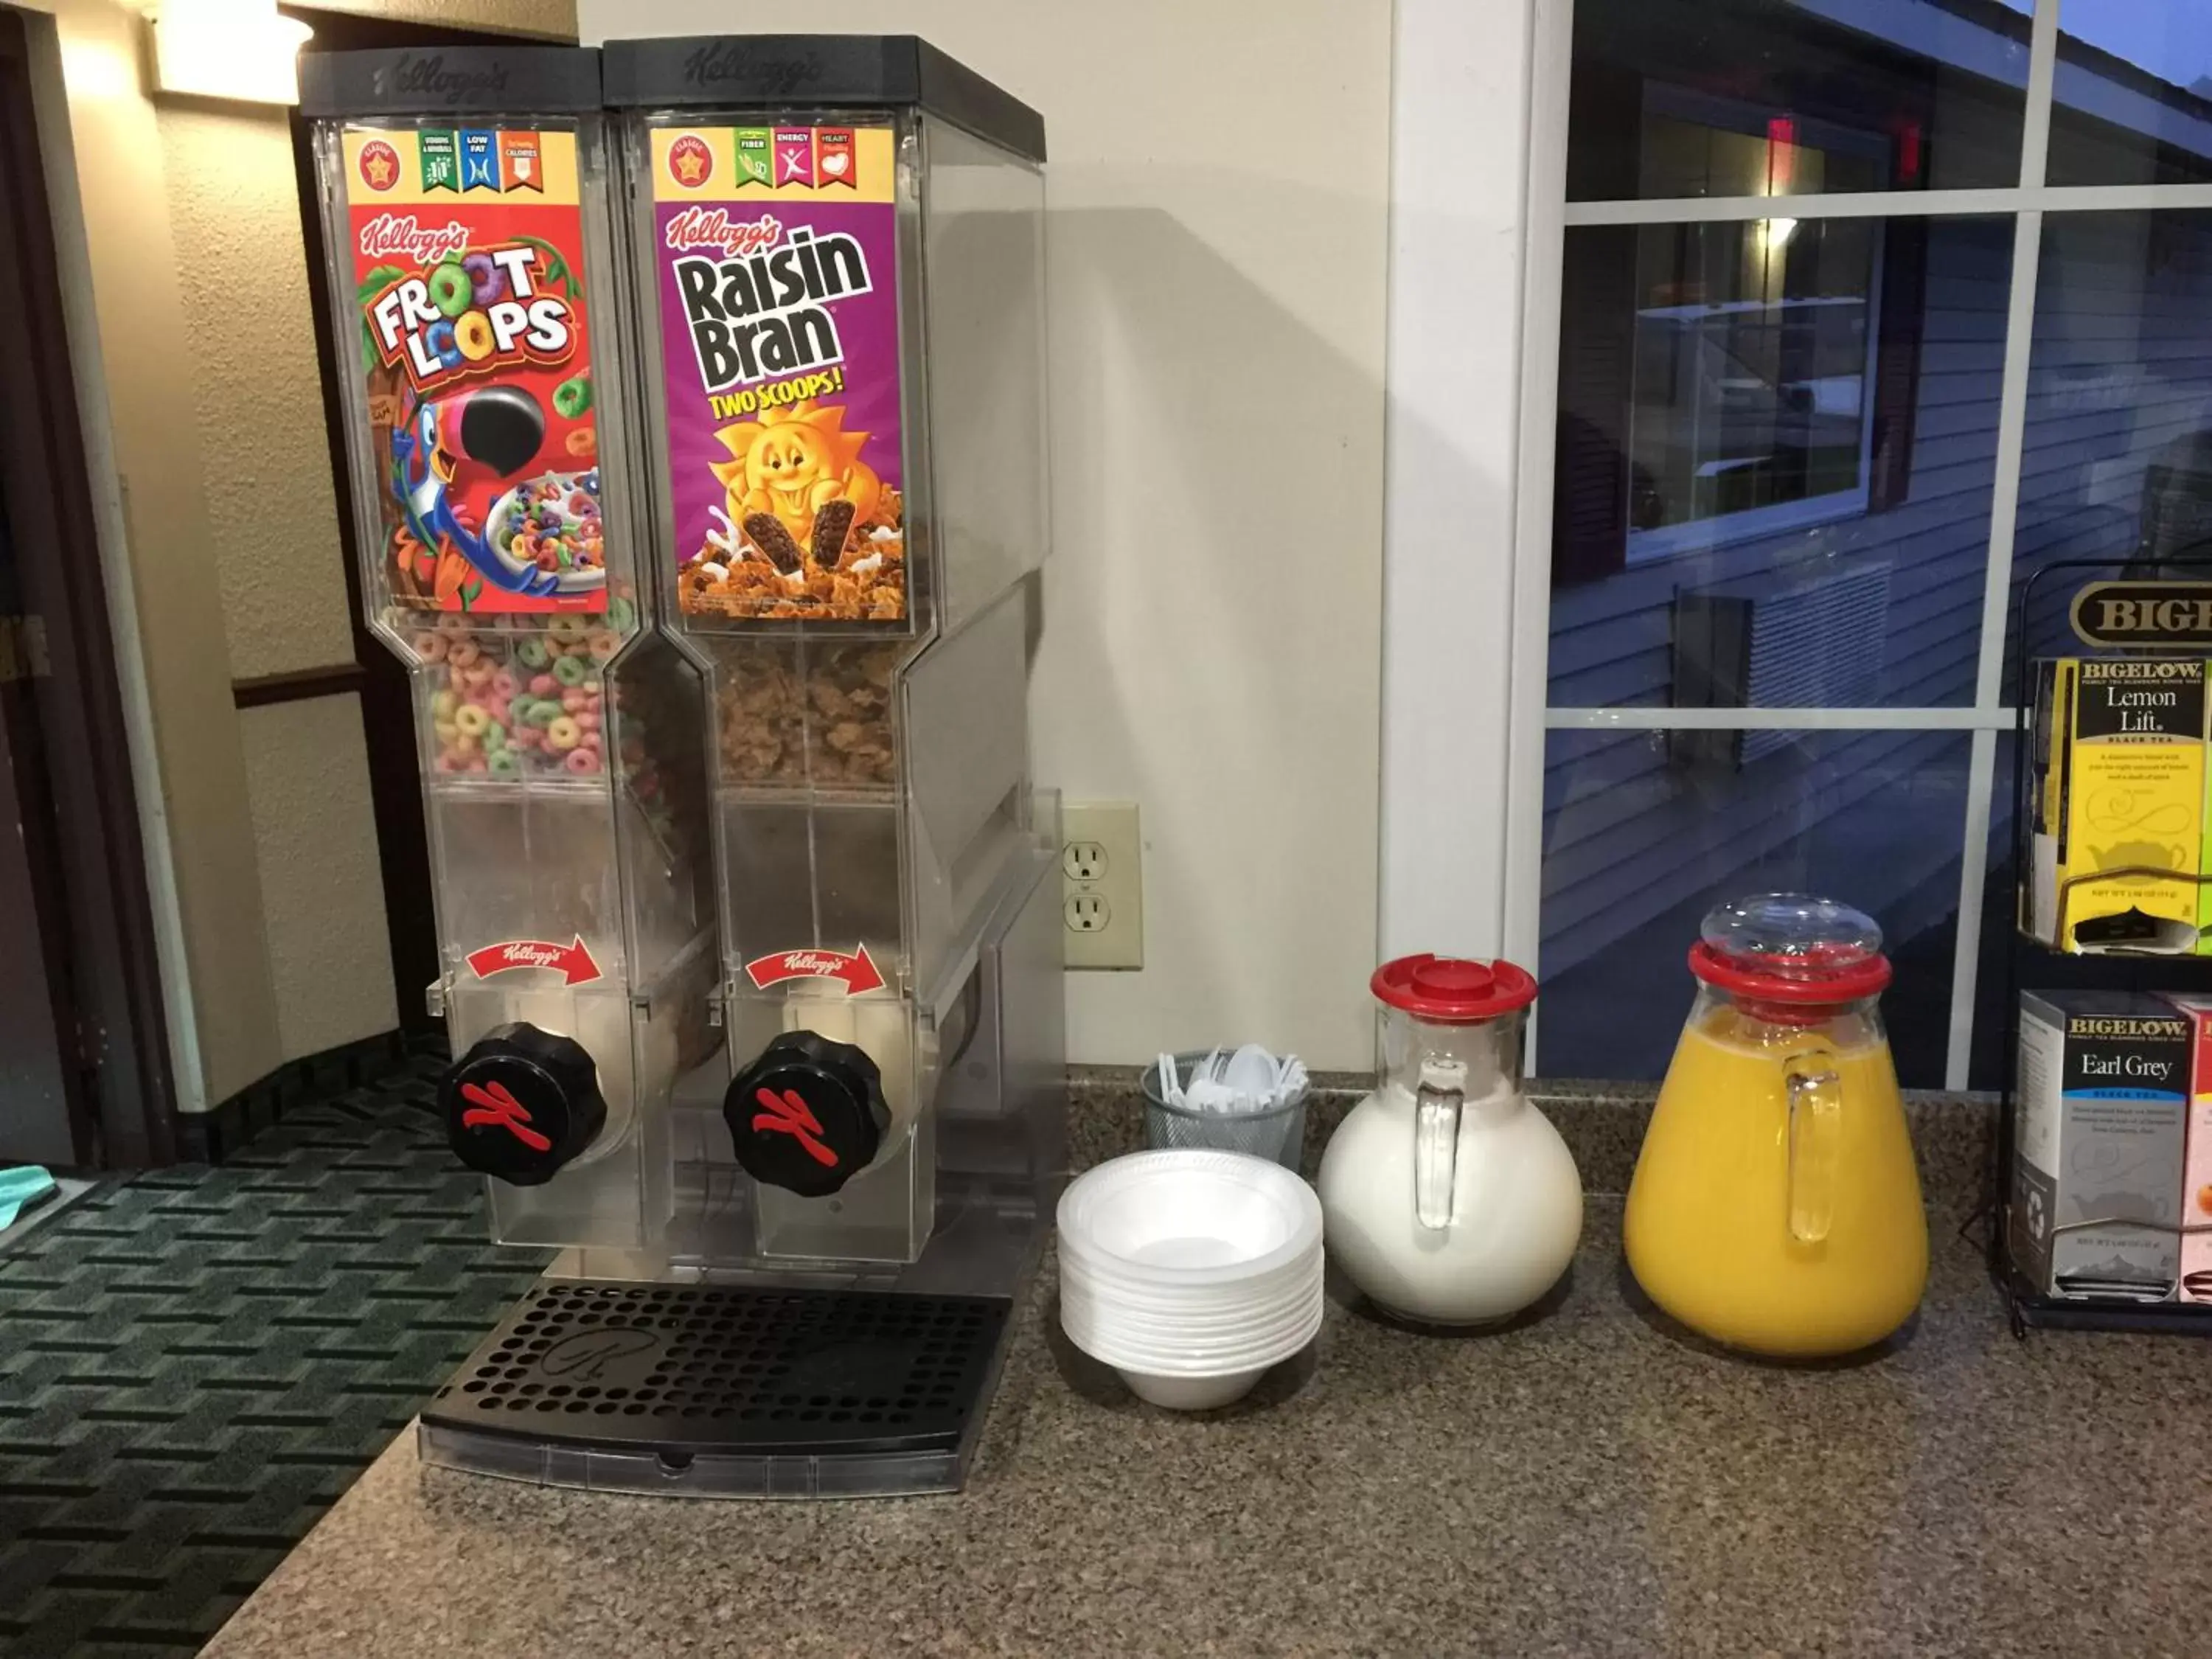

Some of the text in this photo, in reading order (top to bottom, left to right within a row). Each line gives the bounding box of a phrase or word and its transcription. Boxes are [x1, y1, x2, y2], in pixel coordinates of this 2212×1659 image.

[741, 140, 765, 148] FIBER
[776, 133, 809, 142] ENERGY
[361, 214, 468, 263] Kellogg's
[667, 207, 780, 257] Kellogg's
[678, 229, 867, 322] Raisin
[373, 247, 535, 351] FROOT
[406, 299, 568, 378] LOOPS
[692, 307, 838, 388] Bran
[708, 366, 845, 420] TWO SCOOPS!
[2083, 663, 2201, 678] BIGELOW
[2107, 686, 2177, 706] Lemon
[503, 943, 560, 965] Kellogg's
[784, 951, 844, 974] Kellogg's
[2070, 1018, 2186, 1036] BIGELOW
[2081, 1054, 2174, 1081] Earl Grey
